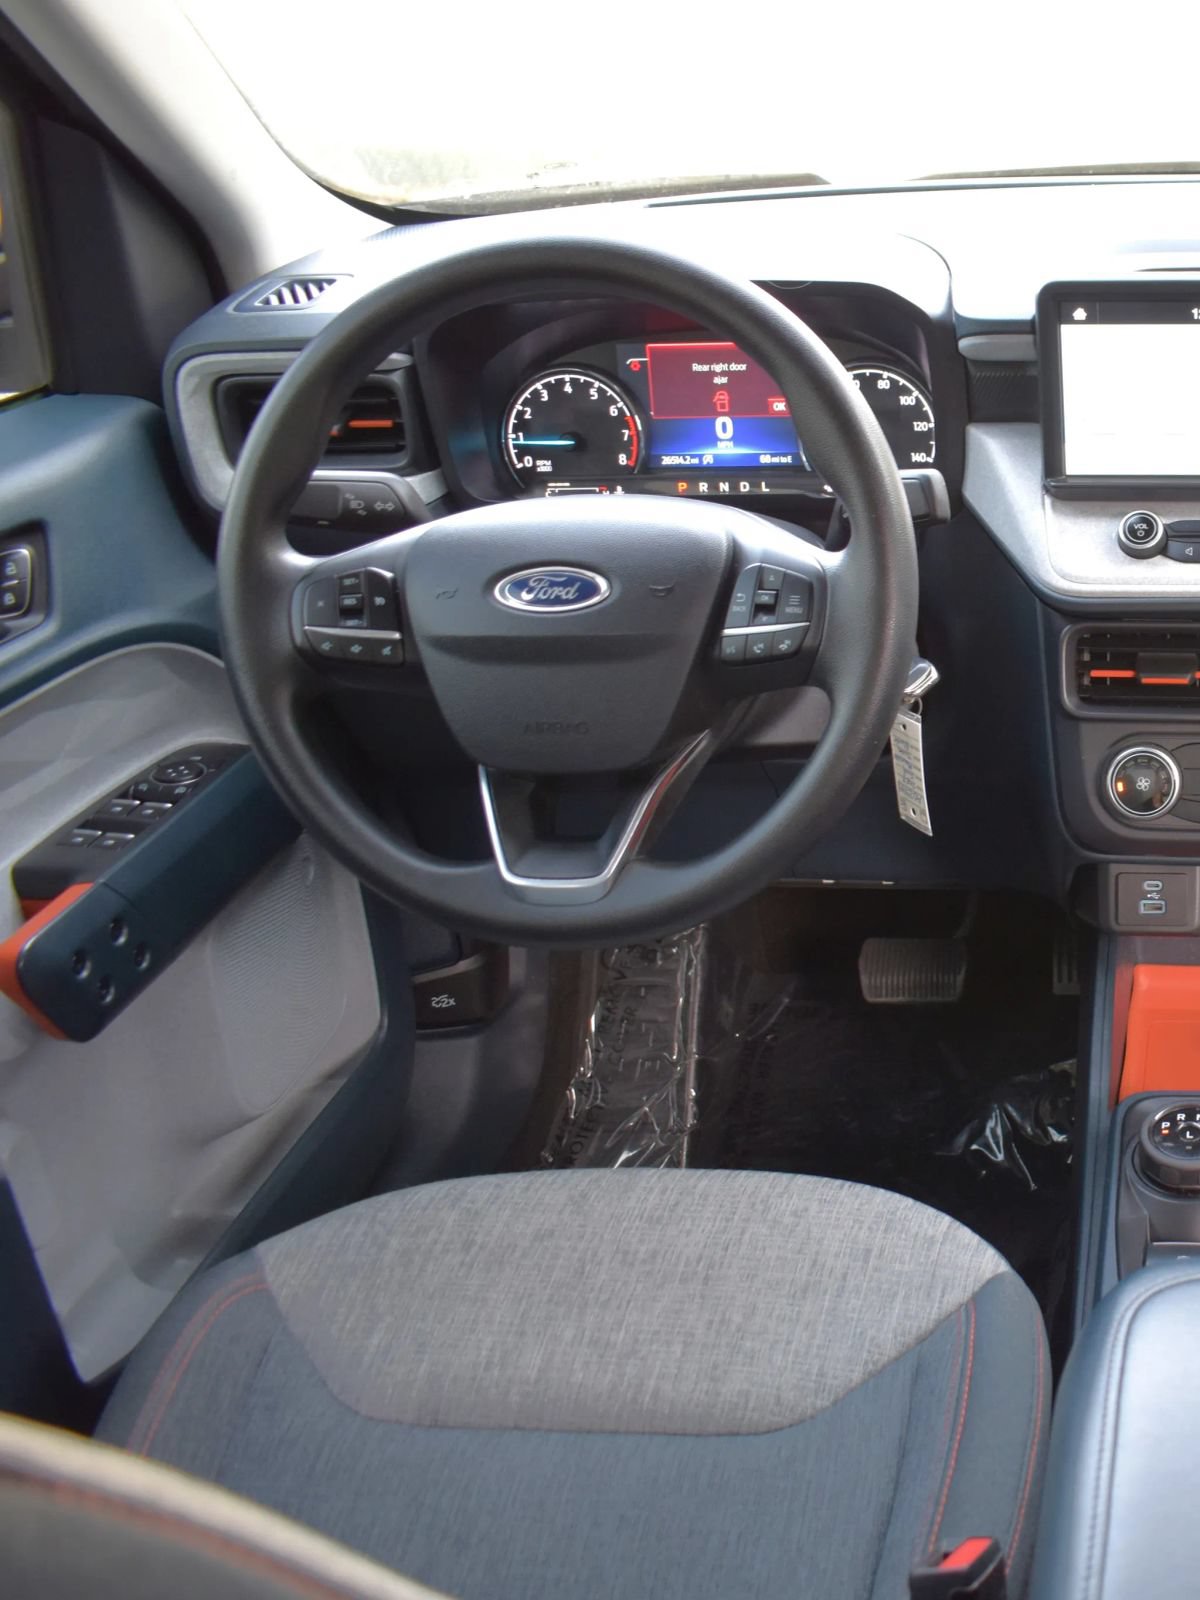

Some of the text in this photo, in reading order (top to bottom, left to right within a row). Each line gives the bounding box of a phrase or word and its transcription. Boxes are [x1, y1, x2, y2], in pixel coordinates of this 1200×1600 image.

[692, 361, 748, 374] Rear right door
[713, 375, 729, 385] ajar
[877, 379, 891, 390] 80
[563, 382, 573, 394] 4
[539, 390, 549, 402] 3
[589, 388, 599, 400] 5
[899, 395, 916, 406] 100
[609, 405, 619, 417] 6
[772, 402, 787, 412] OK
[523, 407, 533, 419] 2
[715, 416, 734, 440] 0
[912, 421, 929, 432] 120
[621, 429, 630, 441] 7
[523, 455, 533, 468] 0
[618, 454, 628, 465] 8
[787, 455, 793, 463] E
[910, 452, 927, 463] 140
[678, 482, 770, 493] P R N D L
[520, 576, 581, 601] Ford
[1176, 1113, 1186, 1121] R
[1161, 1121, 1171, 1129] P
[1185, 1130, 1194, 1139] L
